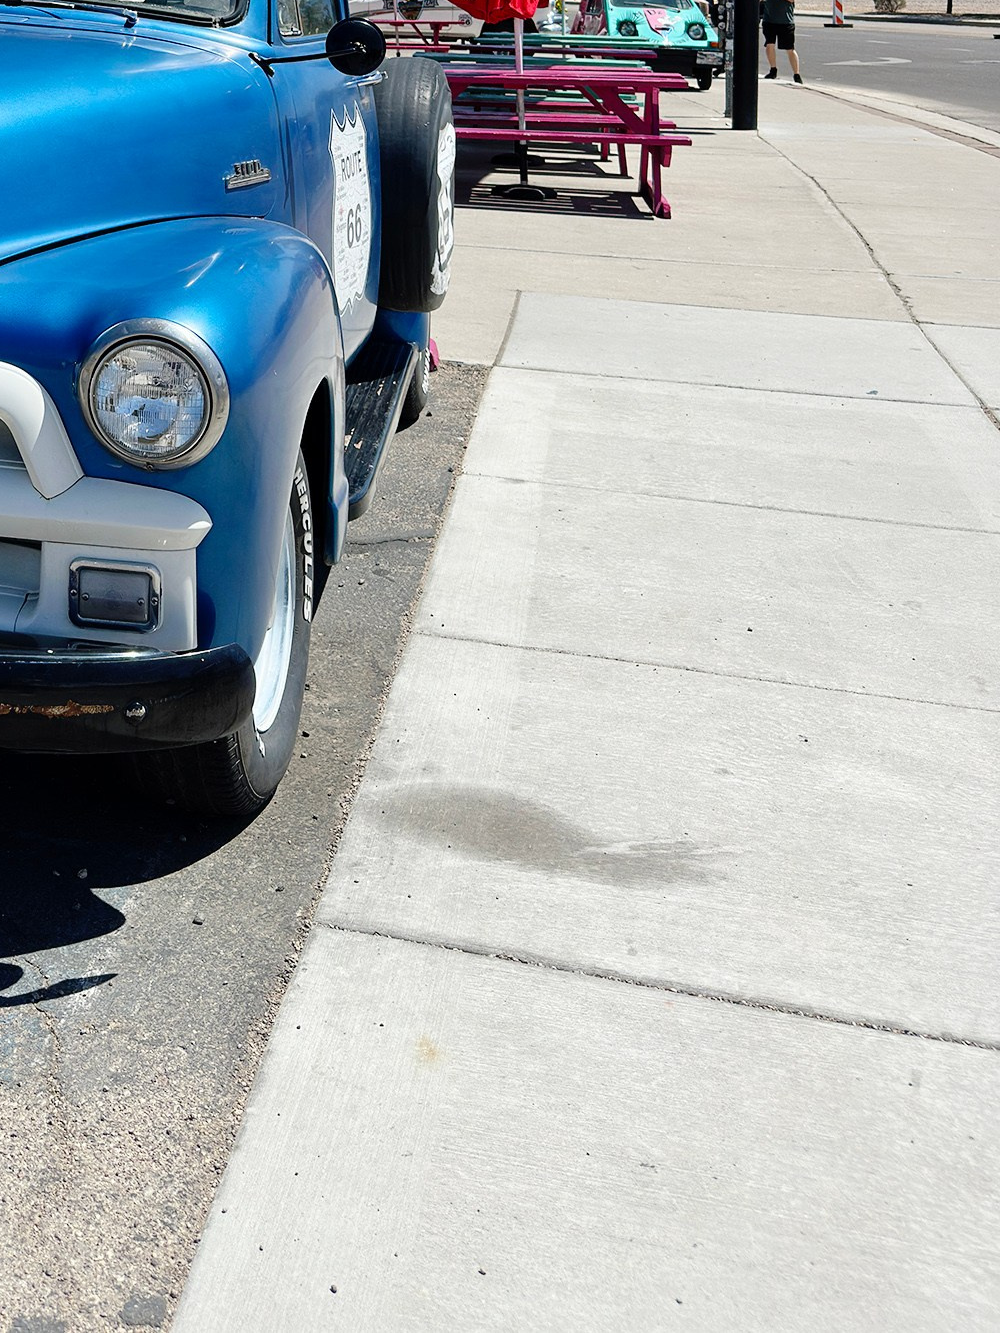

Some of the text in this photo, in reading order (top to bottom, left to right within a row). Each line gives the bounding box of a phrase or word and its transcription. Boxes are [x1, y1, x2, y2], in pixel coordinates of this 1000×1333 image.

[341, 150, 362, 182] ROUTE
[347, 203, 362, 248] 66
[294, 467, 314, 623] HERCULES
